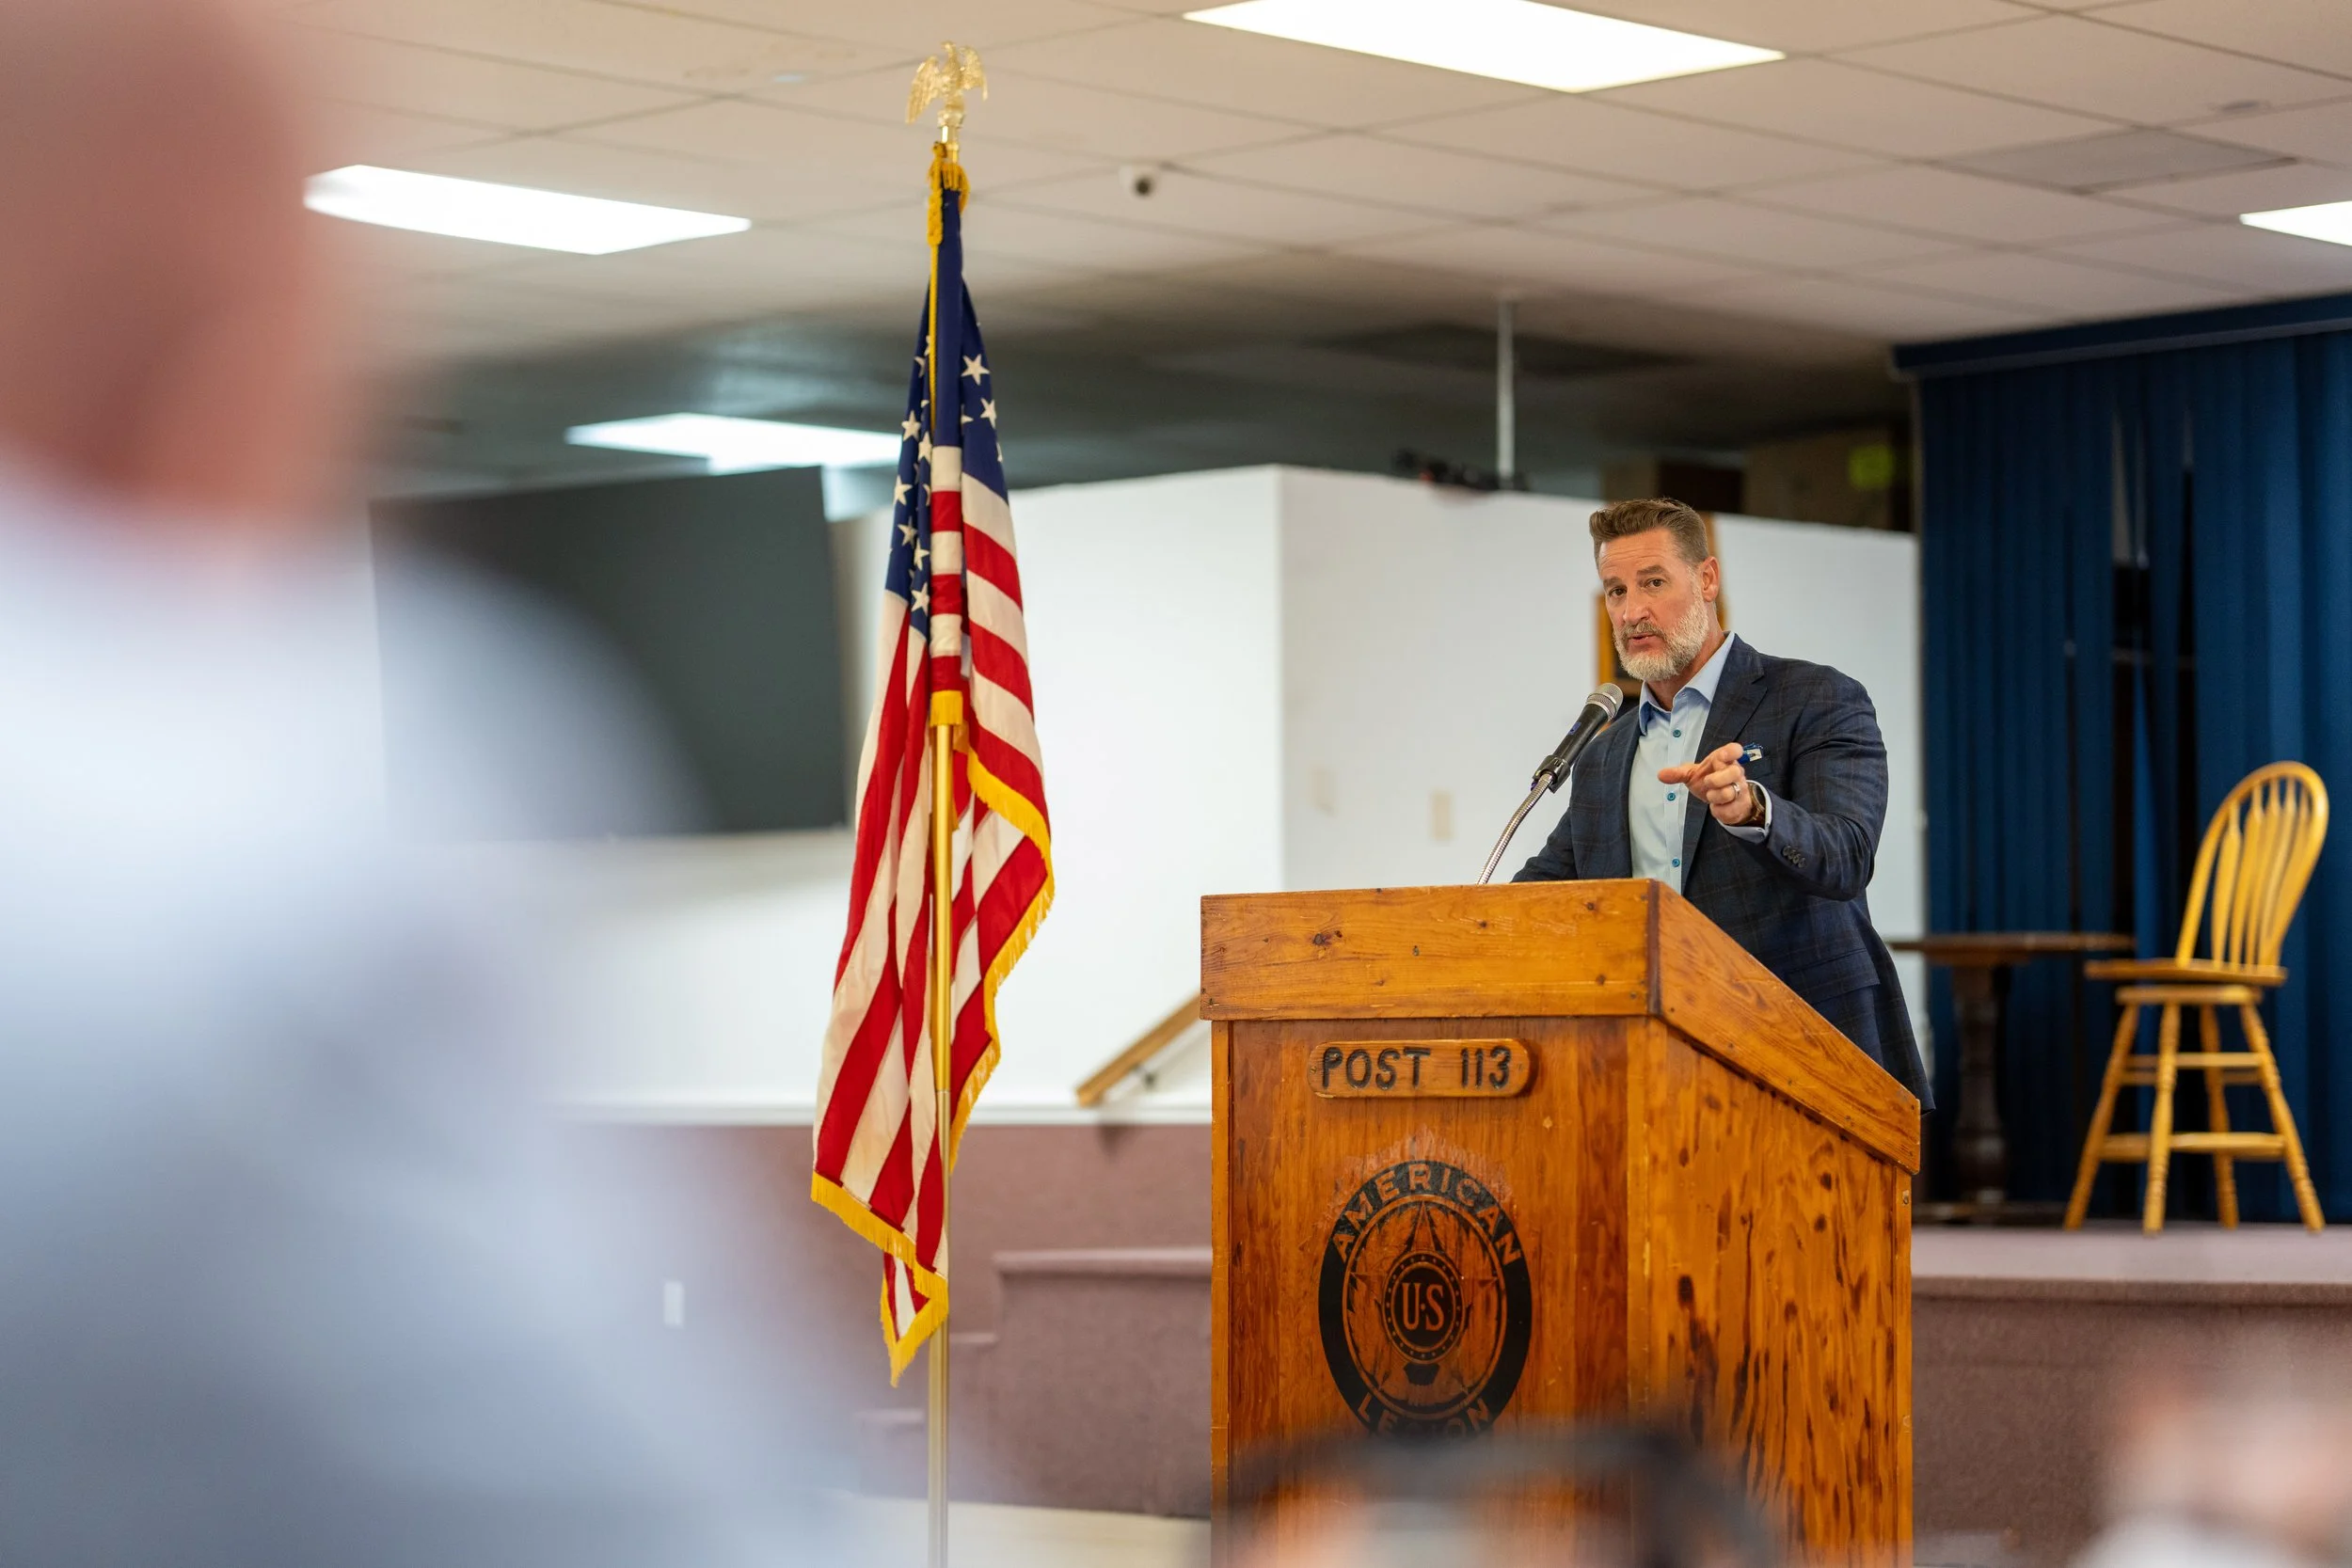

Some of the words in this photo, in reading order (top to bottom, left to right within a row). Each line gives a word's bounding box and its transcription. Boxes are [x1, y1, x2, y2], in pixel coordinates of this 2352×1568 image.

[1322, 1046, 1431, 1090] POST
[1460, 1045, 1513, 1089] 113
[1332, 1163, 1524, 1266] AMERICAN
